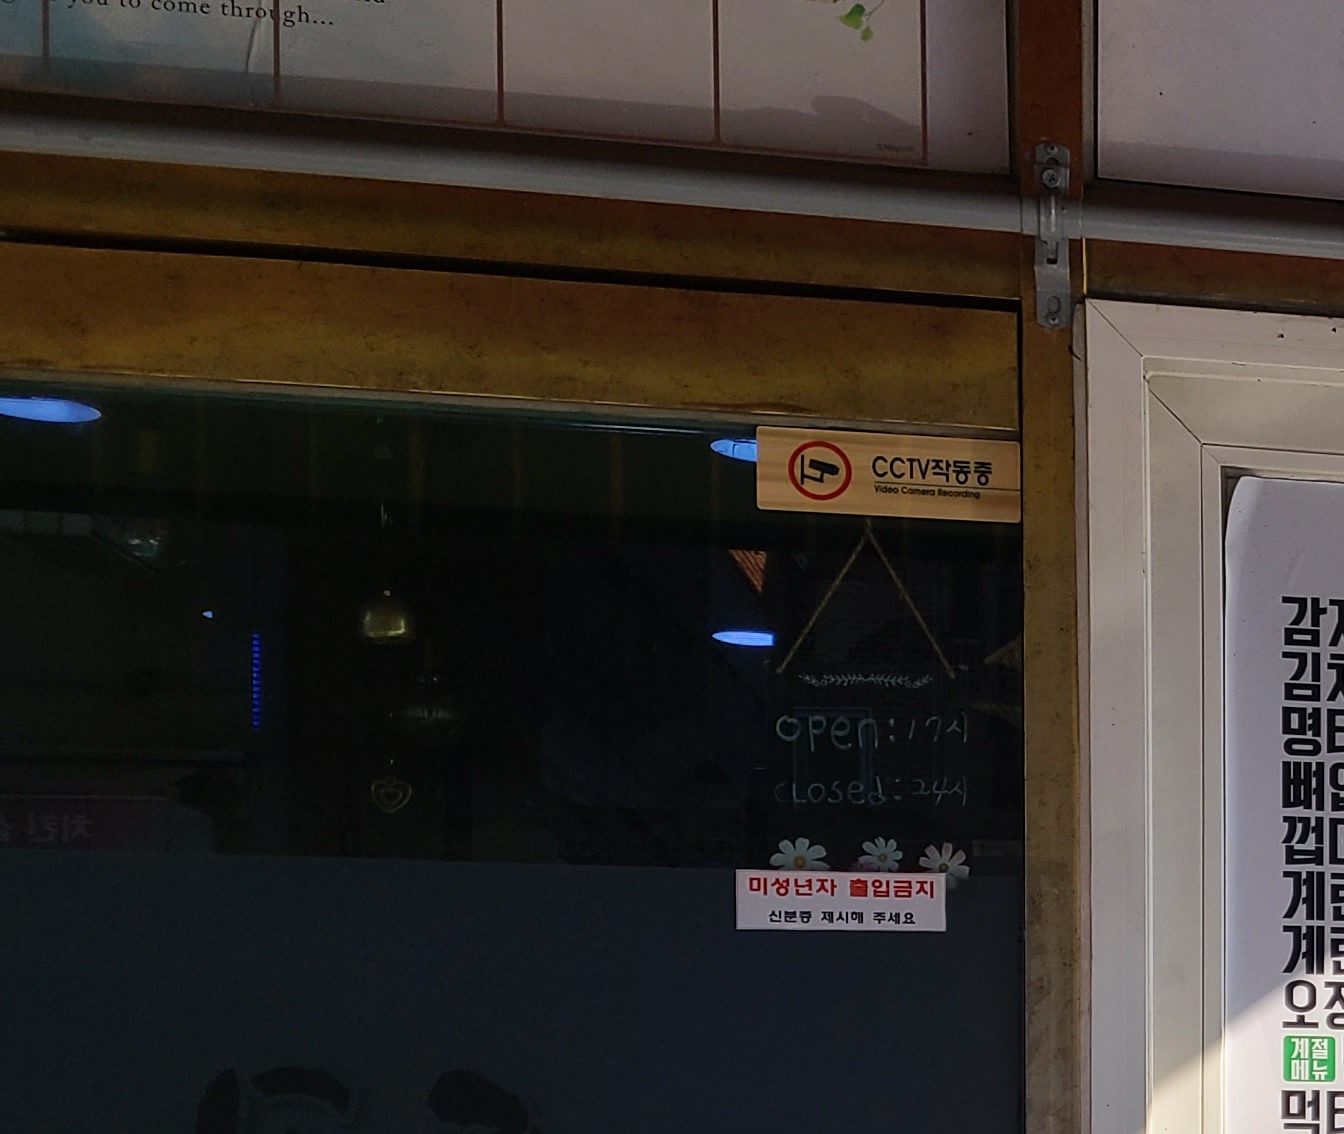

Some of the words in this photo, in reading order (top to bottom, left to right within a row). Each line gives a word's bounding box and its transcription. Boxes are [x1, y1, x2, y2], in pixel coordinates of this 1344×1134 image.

[151, 0, 211, 15] come
[871, 455, 993, 487] CCTV작동중
[873, 485, 900, 495] Video
[901, 486, 936, 497] Camera
[937, 488, 981, 500] Recording
[748, 876, 838, 897] 미성년자
[849, 878, 935, 899] 출입금지
[768, 909, 812, 924] 신분증
[820, 910, 864, 925] 제시해
[872, 911, 916, 925] 주세요
[1290, 1037, 1330, 1060] 계절
[1290, 1059, 1330, 1081] 메뉴
